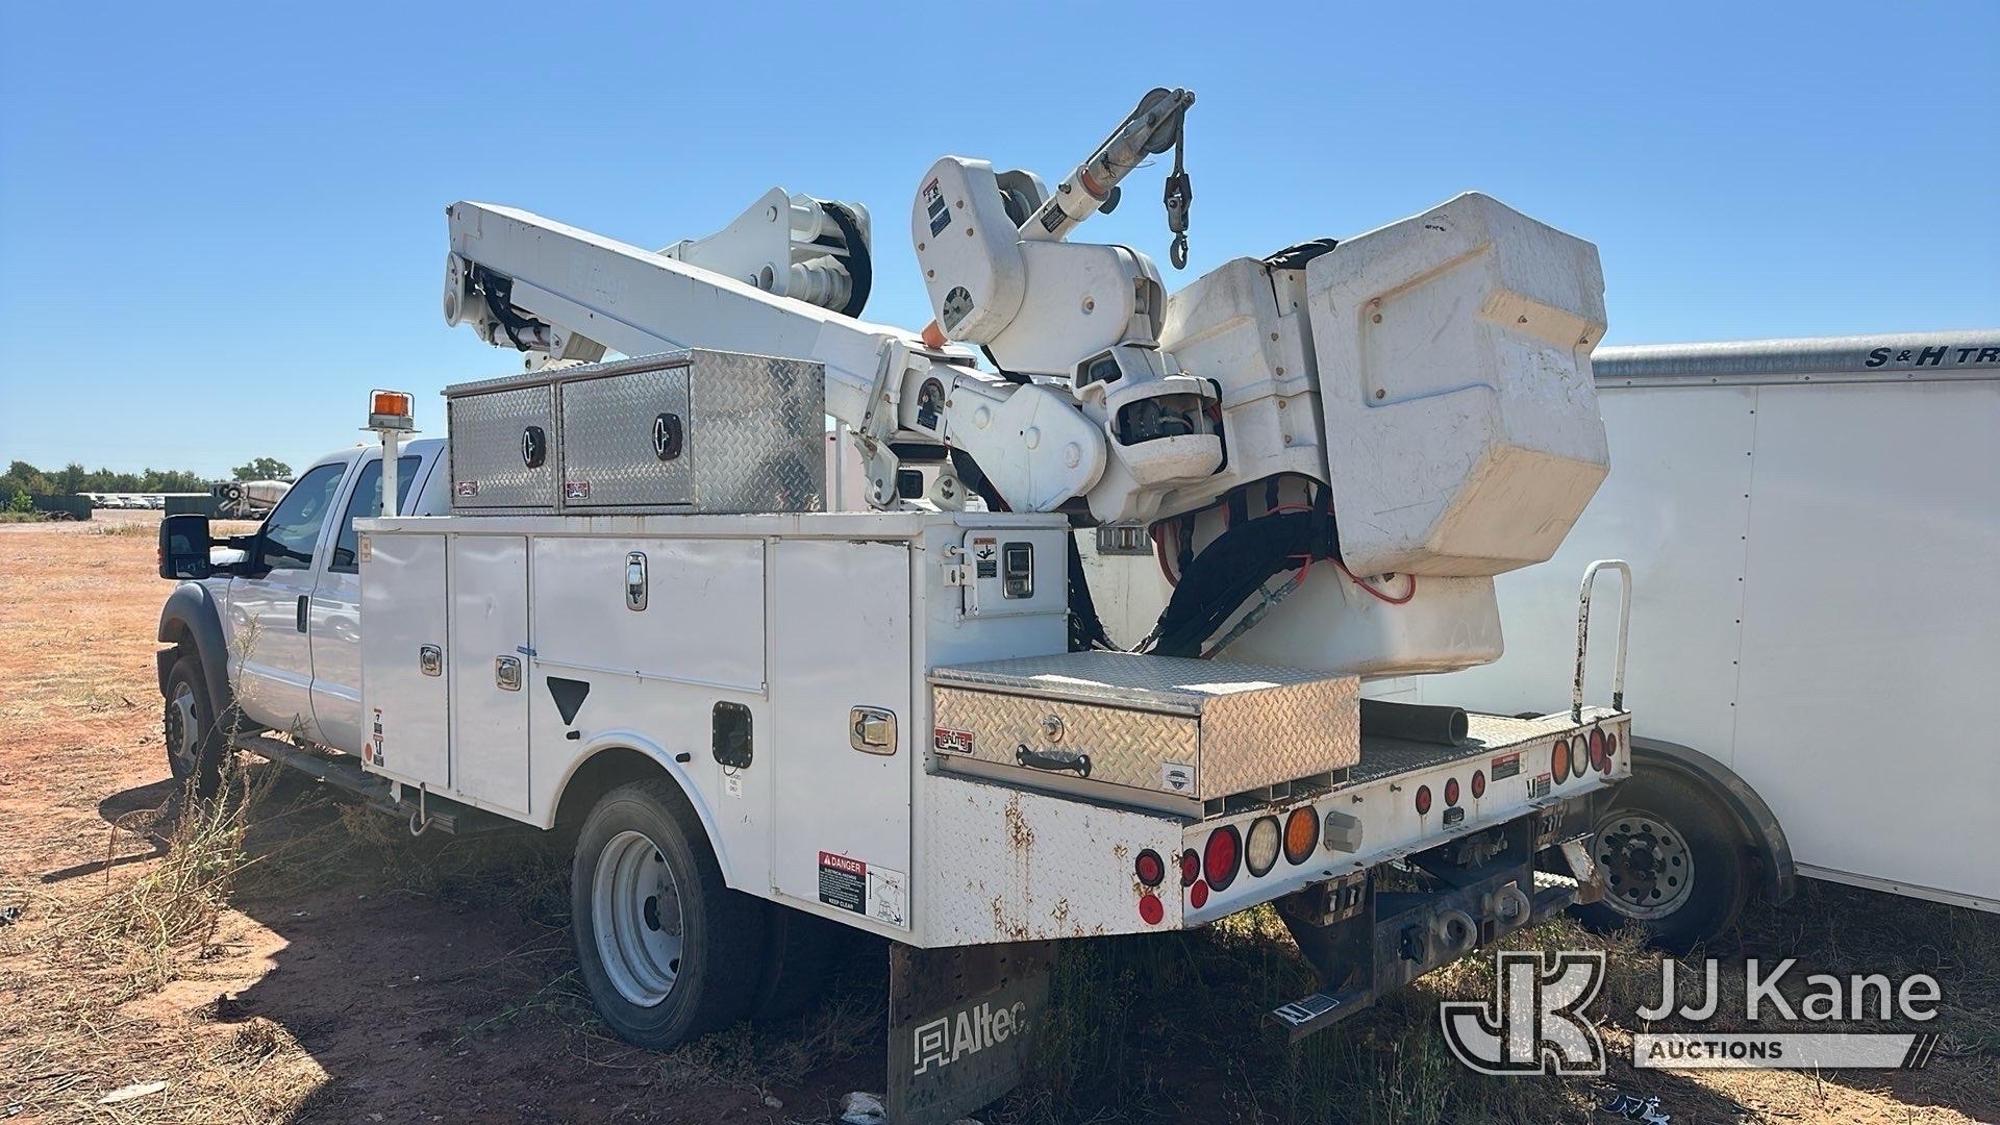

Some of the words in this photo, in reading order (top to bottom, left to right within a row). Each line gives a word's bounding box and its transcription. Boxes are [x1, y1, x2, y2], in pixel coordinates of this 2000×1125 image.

[1865, 347, 1891, 367] S
[1915, 345, 1949, 366] H
[832, 857, 860, 872] DANGER
[951, 1001, 1025, 1062] Altec
